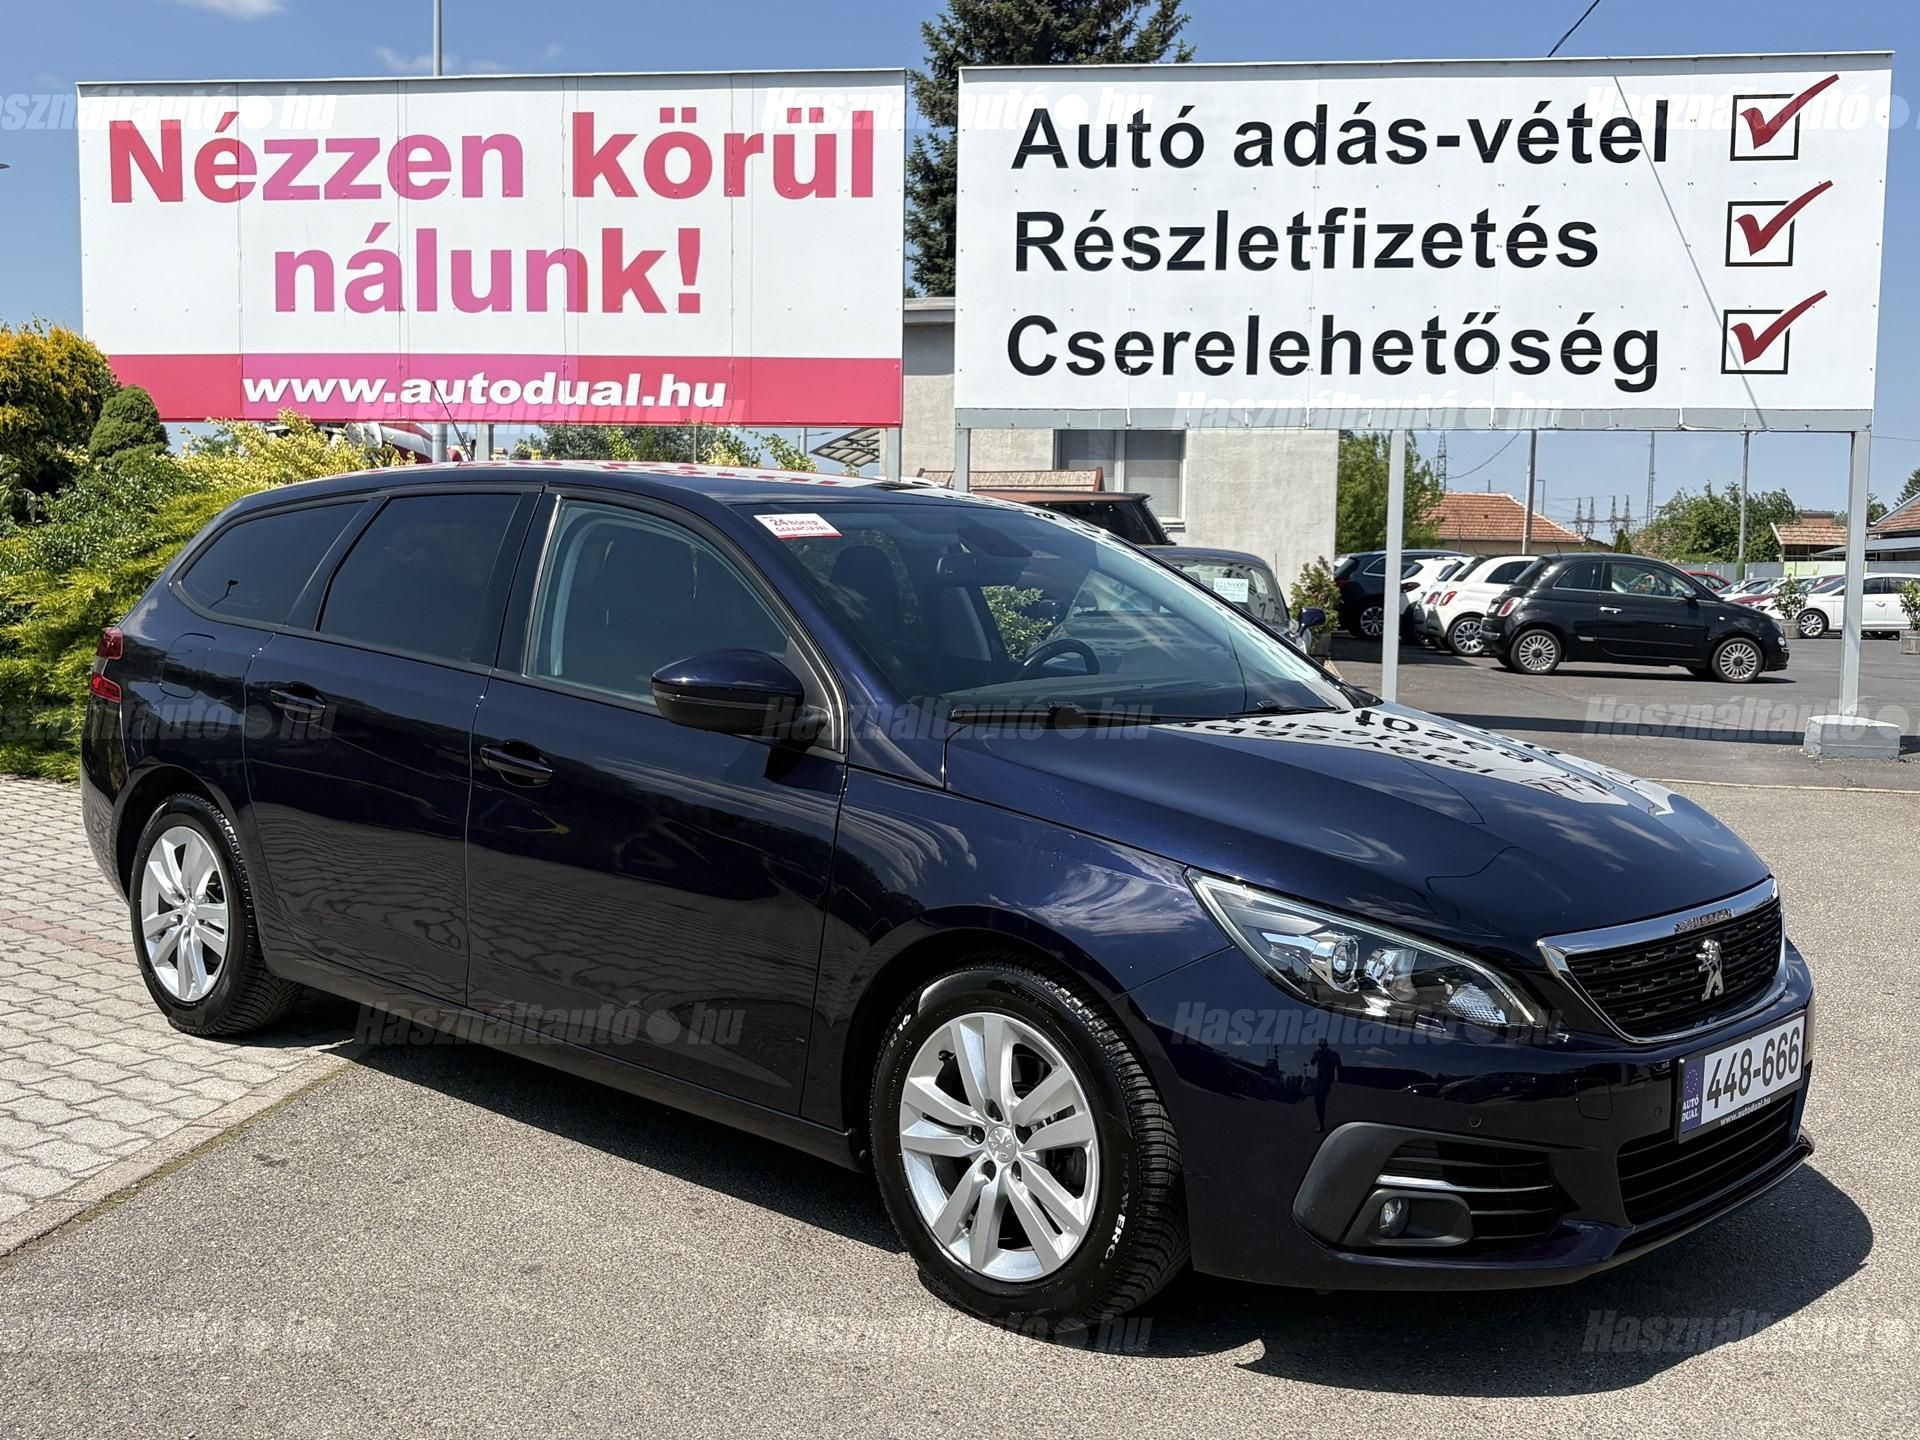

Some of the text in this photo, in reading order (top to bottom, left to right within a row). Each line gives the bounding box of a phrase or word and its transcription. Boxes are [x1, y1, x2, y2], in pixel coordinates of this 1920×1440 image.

[110, 108, 874, 203] Nézzen körül
[1011, 99, 1669, 169] Autó adás-vétel
[275, 222, 704, 314] nálunk!
[1015, 204, 1598, 272] Részletfizetés
[1007, 312, 1658, 393] Cserelehetőség
[242, 371, 727, 408] www.autodual.hu
[1682, 1094, 1700, 1111] AUTÓ
[1706, 1025, 1801, 1110] 448-666
[1681, 1107, 1699, 1122] DUAL
